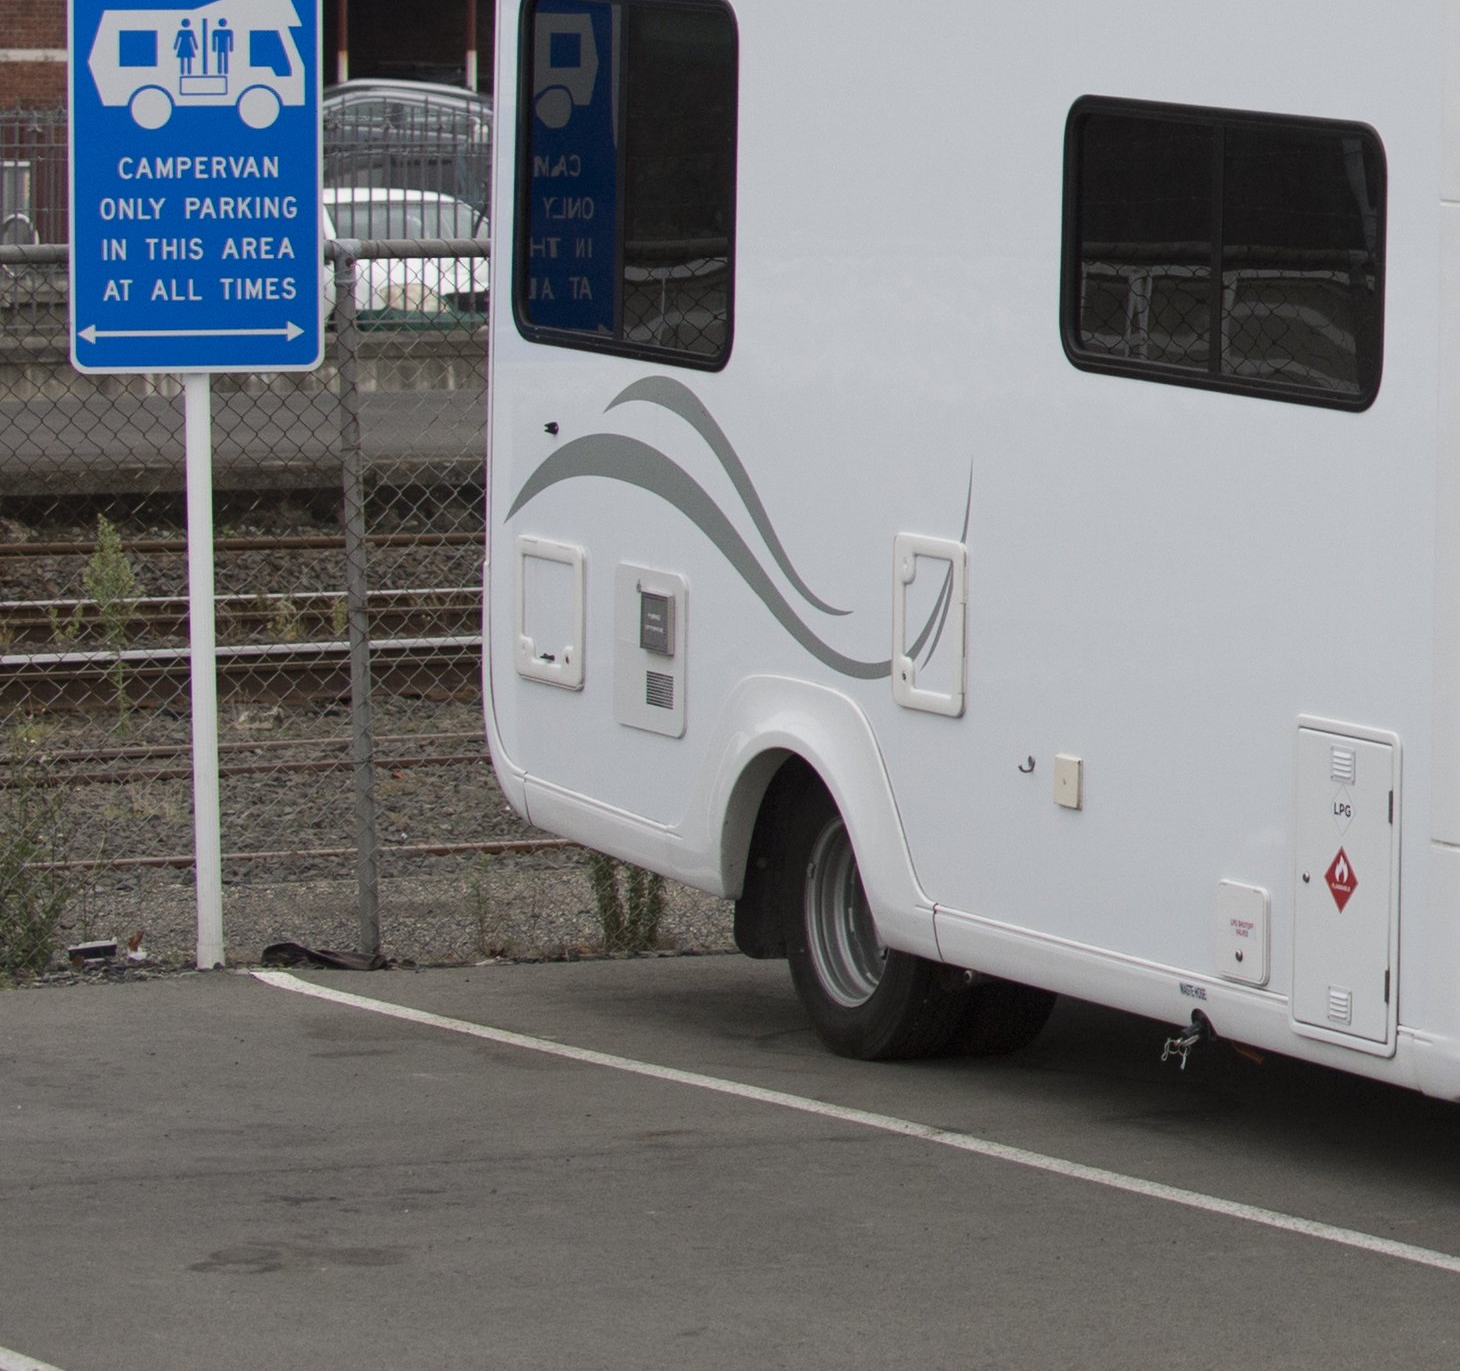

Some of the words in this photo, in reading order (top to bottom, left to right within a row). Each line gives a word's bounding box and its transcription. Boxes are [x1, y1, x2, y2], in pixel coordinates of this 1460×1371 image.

[117, 155, 280, 180] CAMPERVAN
[100, 197, 166, 221] ONLY
[184, 196, 298, 220] PARKING
[102, 238, 128, 261] IN
[145, 238, 204, 261] THIS
[221, 236, 295, 260] AREA
[103, 279, 133, 302] AT
[150, 278, 203, 301] ALL
[219, 277, 297, 301] TIMES
[1333, 801, 1352, 818] LPG
